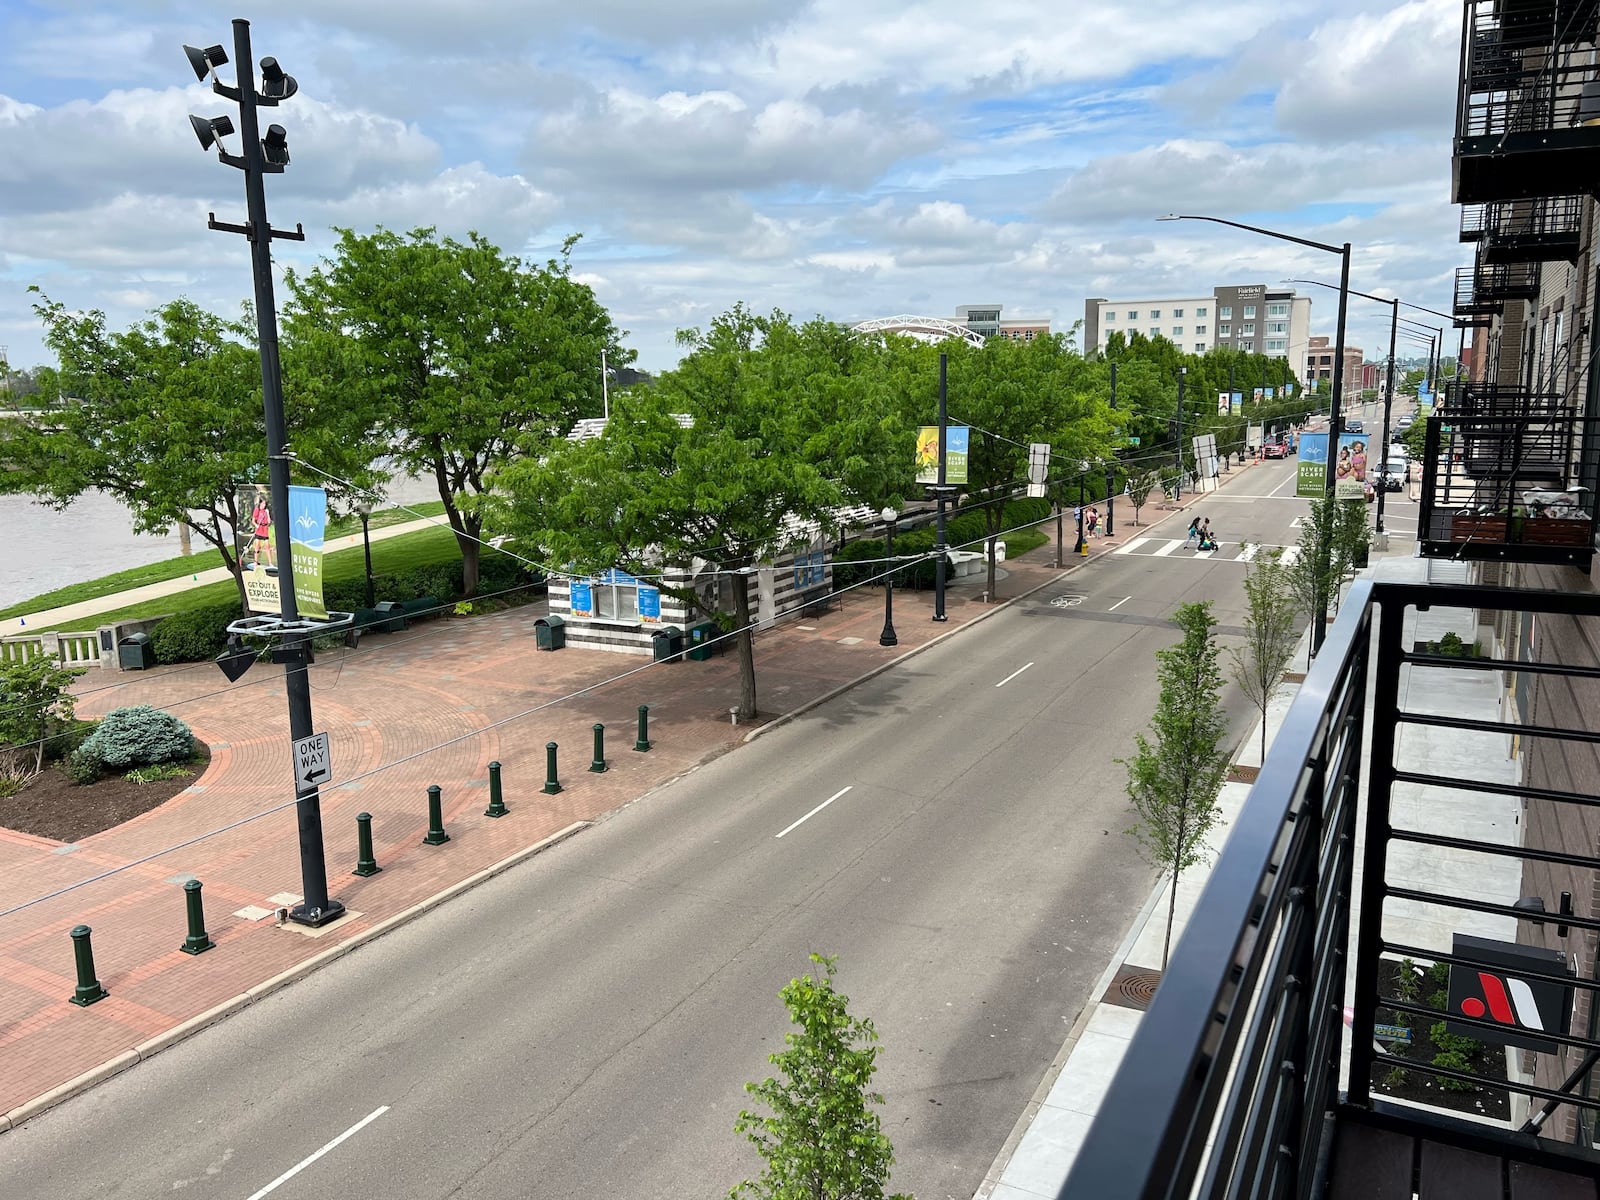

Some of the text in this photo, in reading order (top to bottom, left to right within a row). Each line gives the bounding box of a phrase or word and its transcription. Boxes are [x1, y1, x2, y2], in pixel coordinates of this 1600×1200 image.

[293, 554, 318, 567] RIVER
[294, 564, 318, 576] SCAPE
[258, 582, 270, 590] OUT
[248, 588, 280, 599] EXPLORE
[300, 738, 323, 755] ONE
[301, 750, 325, 769] WAY
